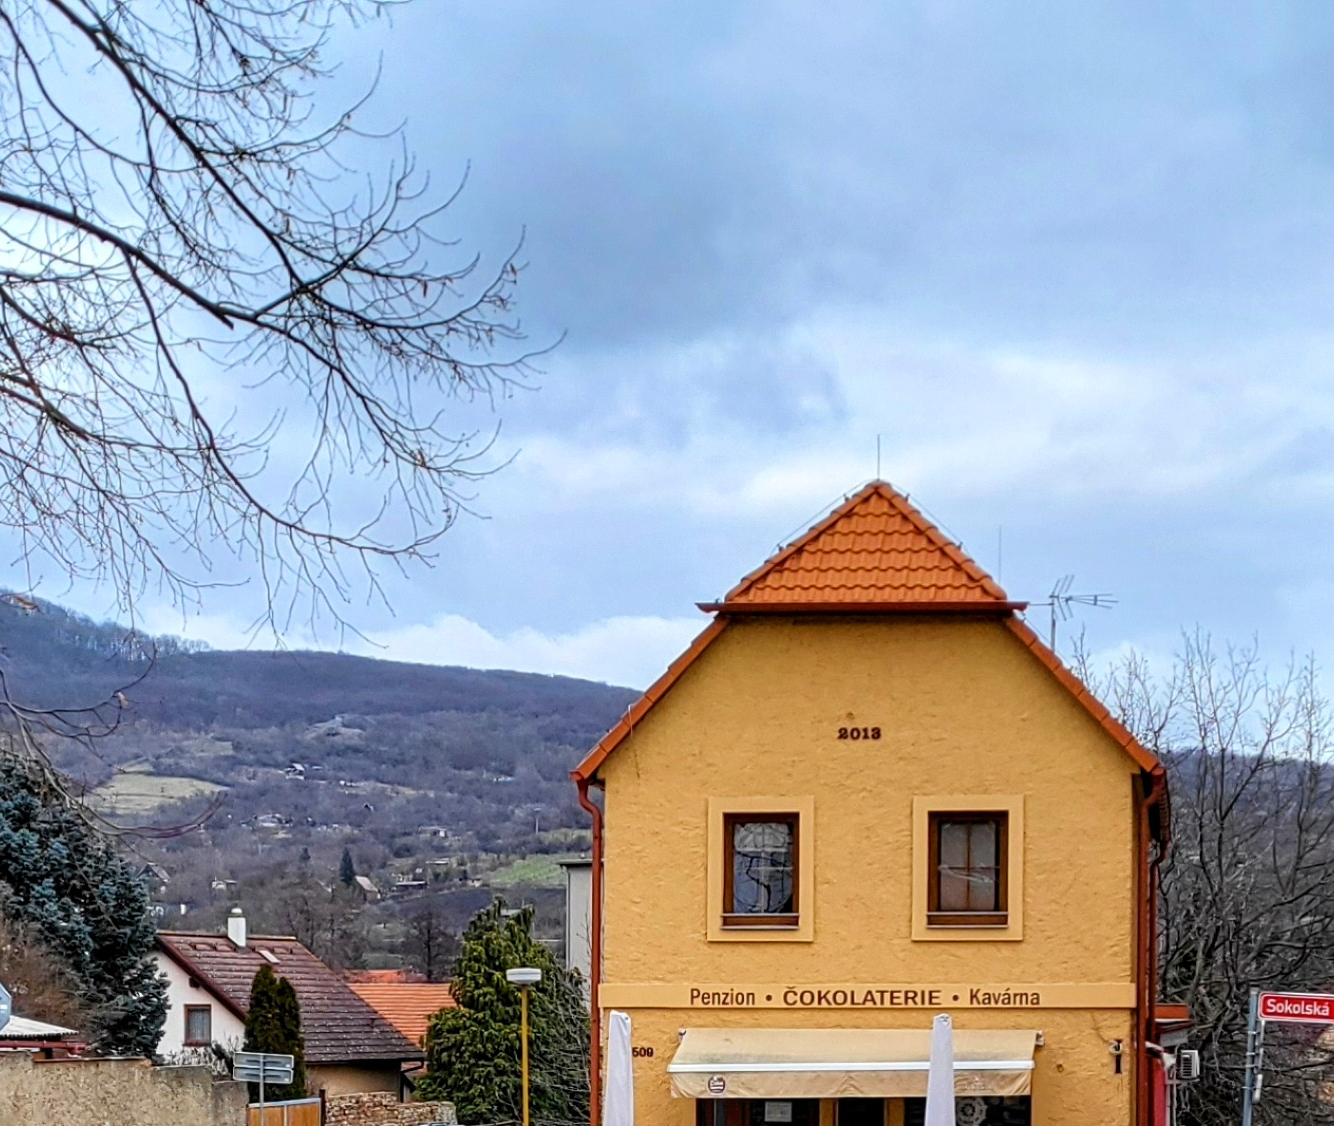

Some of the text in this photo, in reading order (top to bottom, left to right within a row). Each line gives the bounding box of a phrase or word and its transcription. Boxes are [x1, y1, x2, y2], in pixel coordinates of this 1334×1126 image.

[837, 726, 882, 741] 2013
[690, 986, 1041, 1006] Penzion ČOKOLATERIE Kavárna
[1266, 998, 1330, 1017] Sokolská
